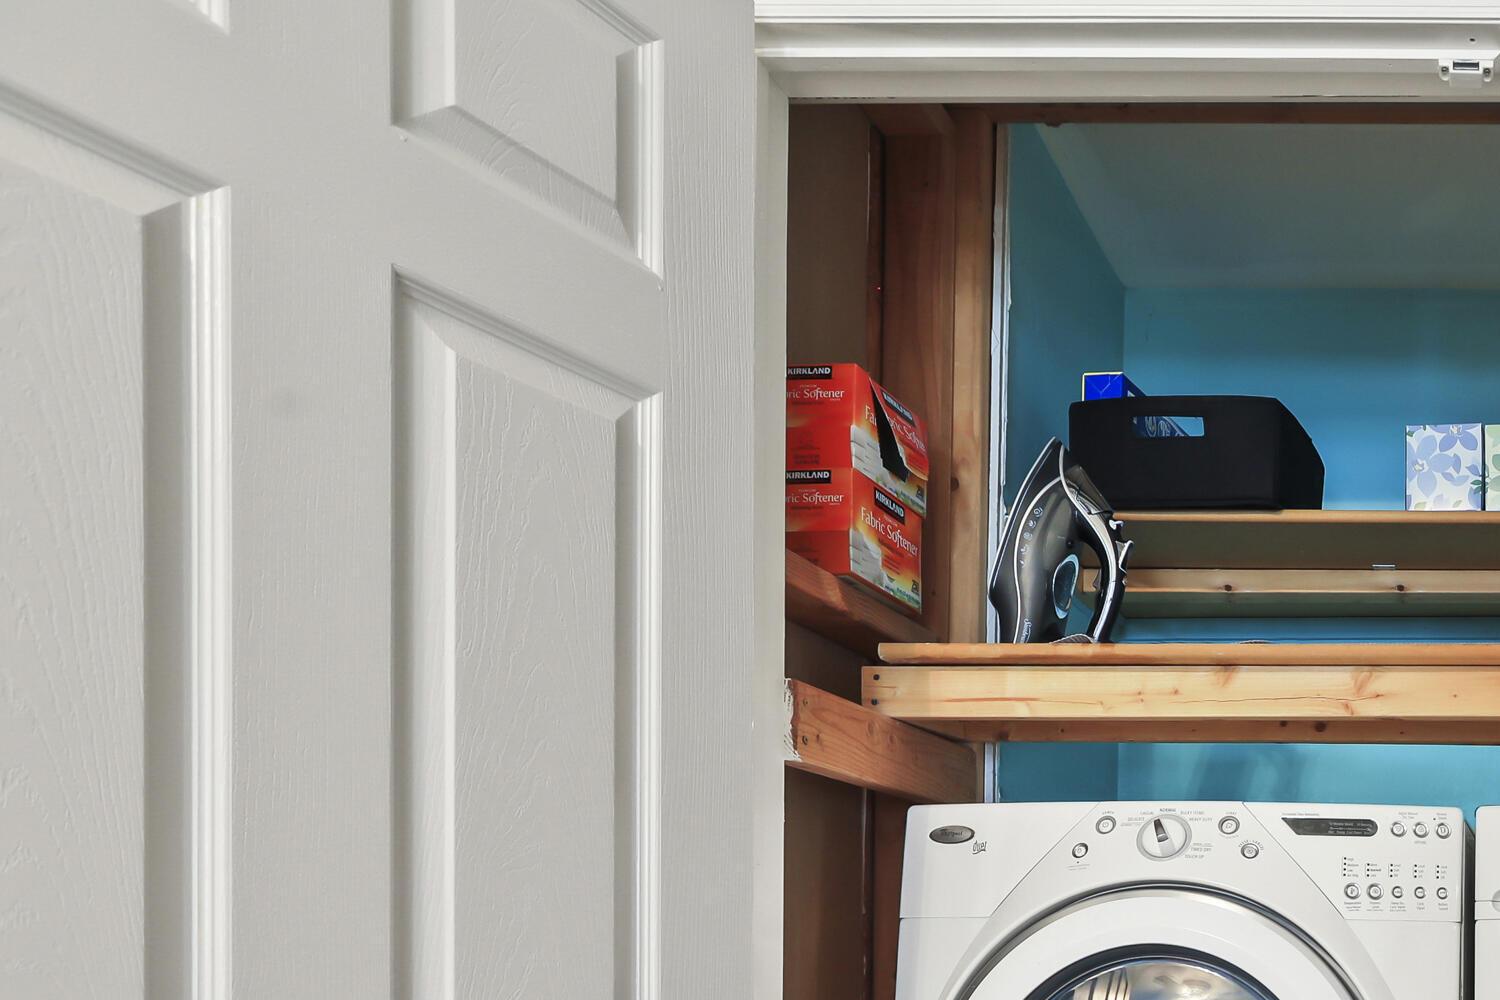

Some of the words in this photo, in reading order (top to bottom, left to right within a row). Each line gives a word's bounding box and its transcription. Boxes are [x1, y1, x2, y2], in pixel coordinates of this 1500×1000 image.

[787, 367, 831, 375] KIRKLAND
[803, 387, 845, 400] Softener
[786, 471, 830, 479] KIRKLAND
[802, 491, 845, 504] Softener
[875, 489, 905, 518] KIRKLAND
[861, 506, 886, 535] Fabric
[887, 525, 919, 556] Softener
